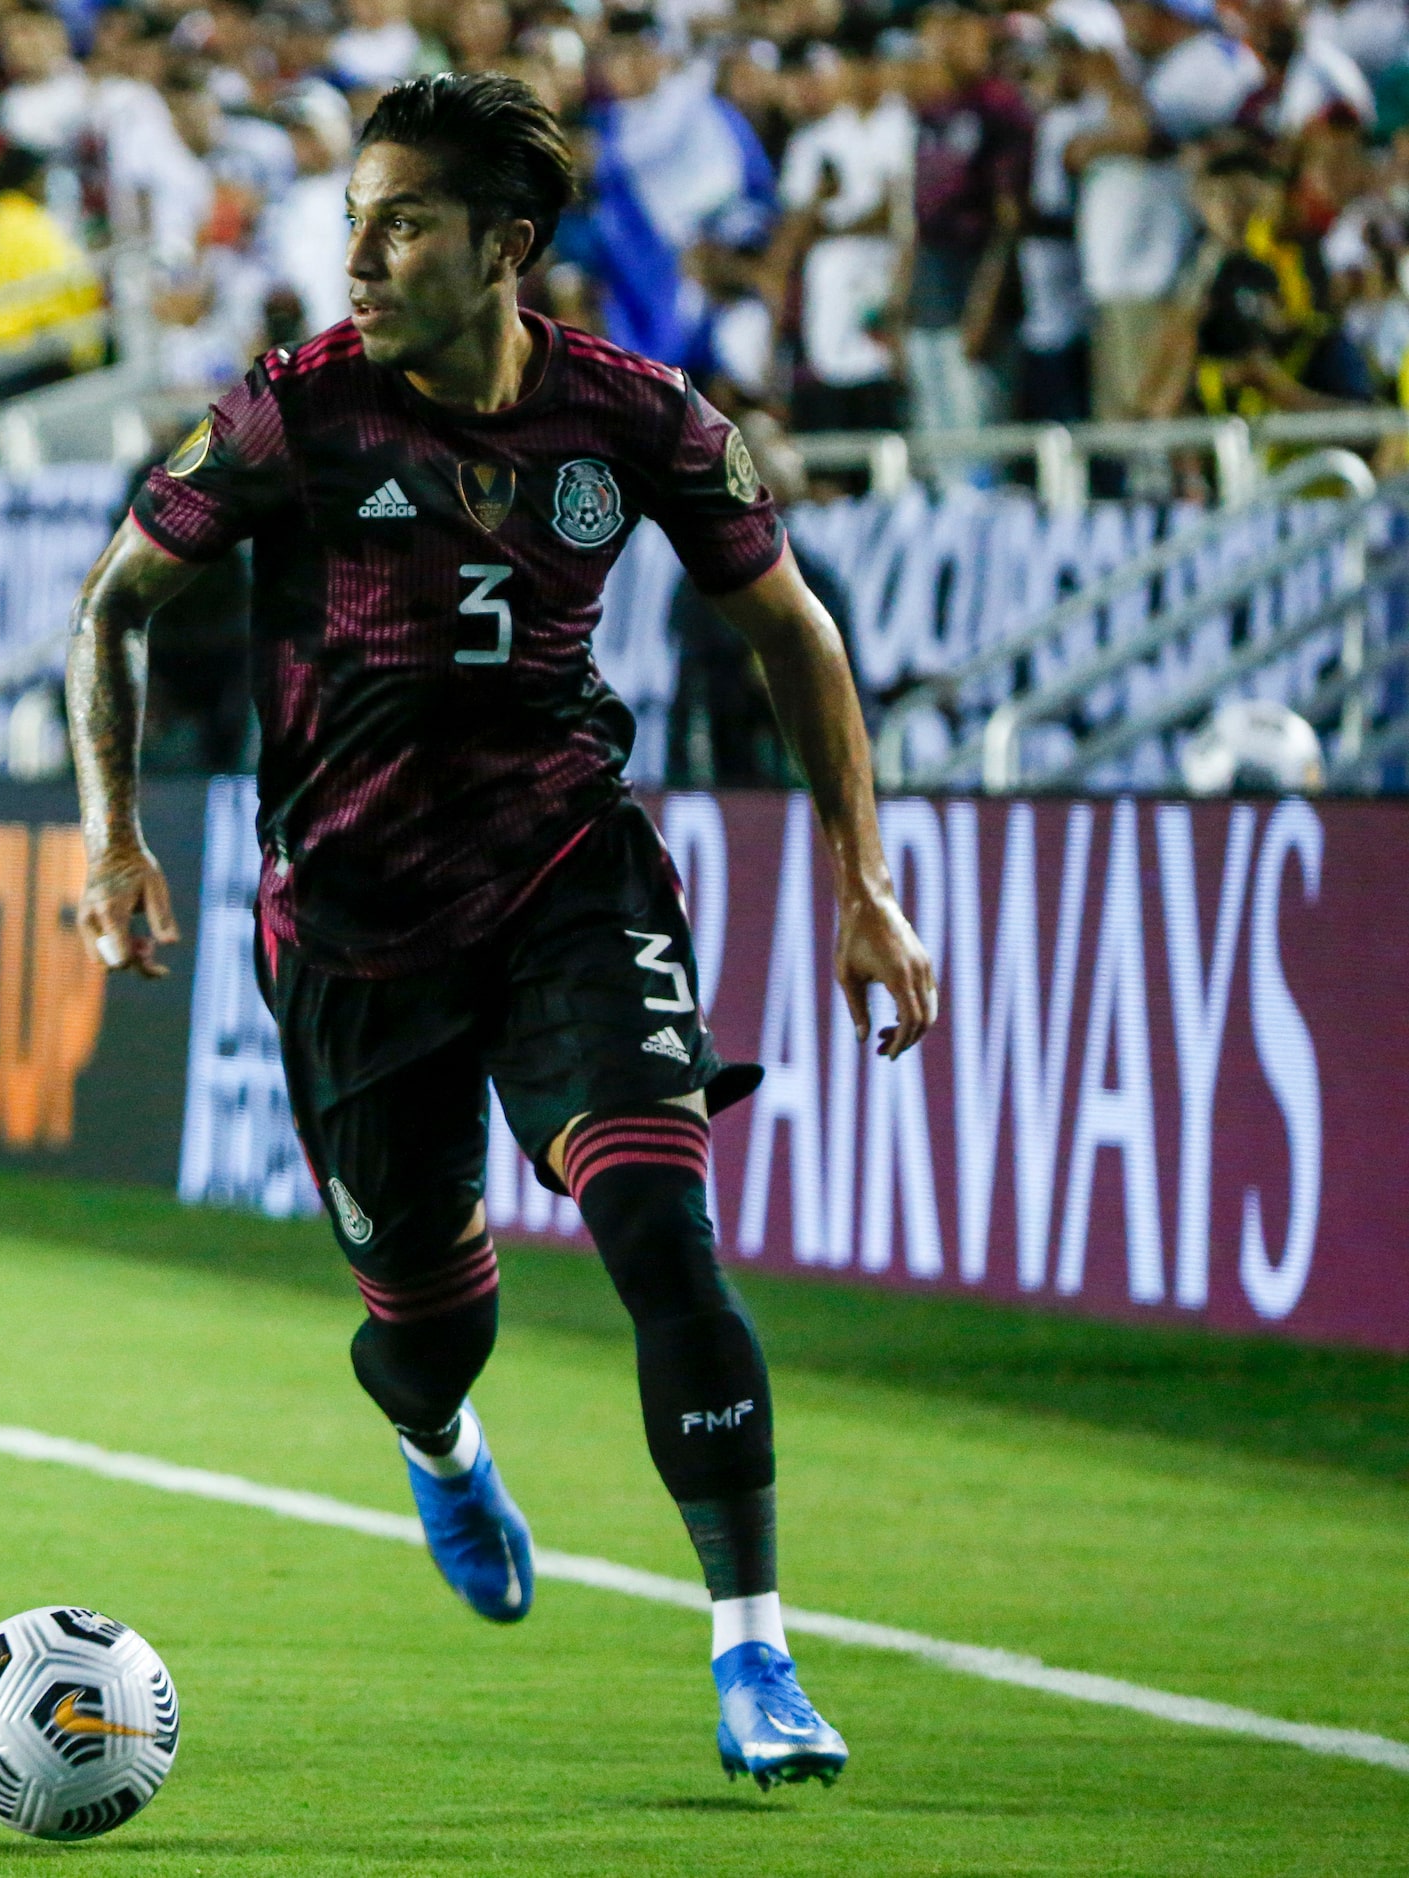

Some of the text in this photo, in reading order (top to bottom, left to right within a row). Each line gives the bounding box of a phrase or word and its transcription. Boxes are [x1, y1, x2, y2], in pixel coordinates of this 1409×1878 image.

[358, 502, 417, 518] adidas
[454, 563, 514, 665] 3
[624, 928, 696, 1014] 3
[736, 790, 1327, 1320] AIRWAYS
[680, 1398, 755, 1436] FMF
